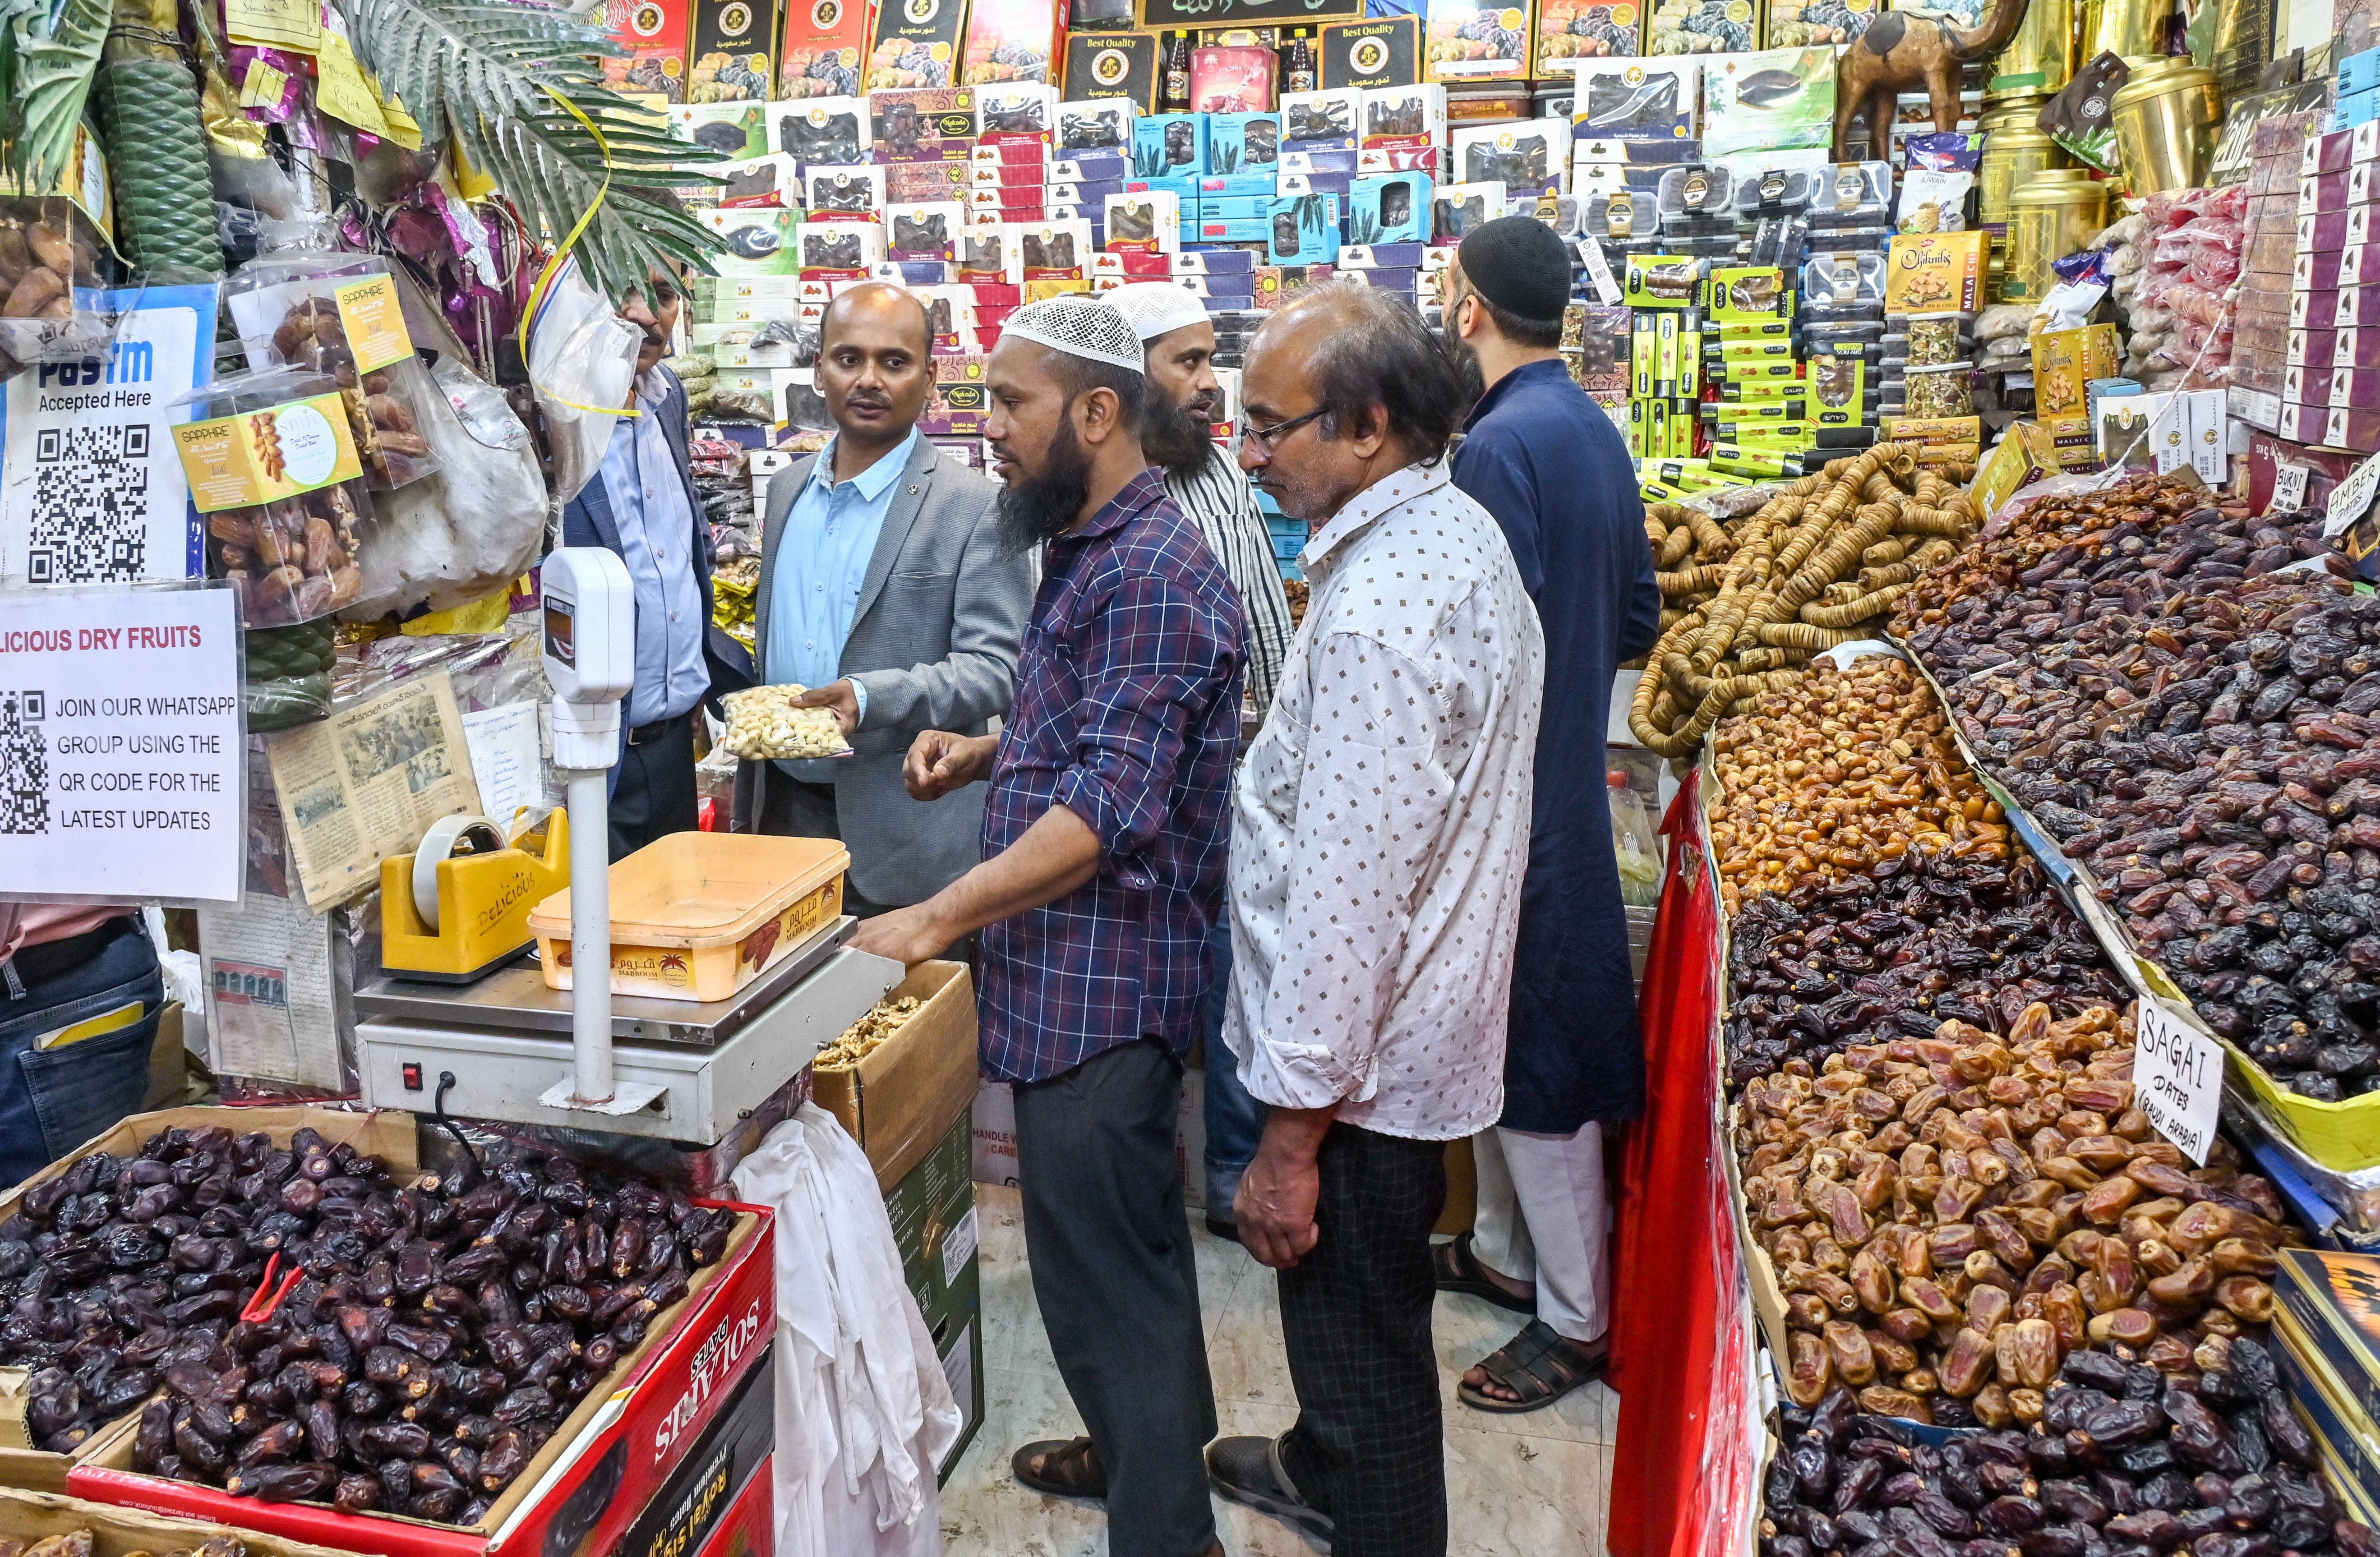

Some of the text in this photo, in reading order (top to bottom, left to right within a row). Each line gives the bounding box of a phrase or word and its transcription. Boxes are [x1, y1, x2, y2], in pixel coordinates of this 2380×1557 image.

[899, 26, 921, 34] سعودية
[1343, 24, 1394, 37] Best Quality
[716, 40, 737, 48] سعودية
[1088, 38, 1136, 49] Best Quality
[1374, 76, 1389, 85] تمور
[1088, 89, 1127, 97] تمور سعودية
[943, 119, 966, 128] Nakoda
[1901, 249, 1951, 269] Chikniks
[343, 284, 384, 305] SAPPHIRE
[1717, 285, 1726, 307] GAURI
[1964, 275, 1974, 309] MALAI
[2040, 349, 2072, 372] Chikniks
[39, 391, 151, 414] Accepted Here
[952, 390, 975, 400] Nakoda
[182, 425, 229, 442] SAPPHIRE
[2277, 469, 2302, 491] BURNI
[2330, 465, 2375, 514] AMBER
[2336, 492, 2363, 520] DATES
[79, 628, 121, 650] DRY
[128, 625, 201, 648] FRUITS
[56, 696, 235, 717] JOIN OUR WHATSAPP
[58, 735, 220, 754] GROUP USING THE
[60, 773, 220, 792] QR CODE FOR THE
[61, 811, 210, 829] LATEST UPDATES
[476, 875, 535, 927] DELICIOUS
[786, 914, 816, 943] MABROOM
[2140, 1008, 2207, 1089] SAGAI
[2154, 1075, 2189, 1111] DATES
[2138, 1088, 2202, 1161] (SAUDI ARABIA)
[973, 1128, 1008, 1142] HANDLE
[992, 1147, 1015, 1157] CARE
[888, 1201, 900, 1217] HELL
[891, 1208, 904, 1226] NUTS
[922, 1292, 927, 1304] 13
[691, 1314, 729, 1382] DATES
[670, 1443, 727, 1532] Premium Dates
[689, 1468, 727, 1538] Royal
